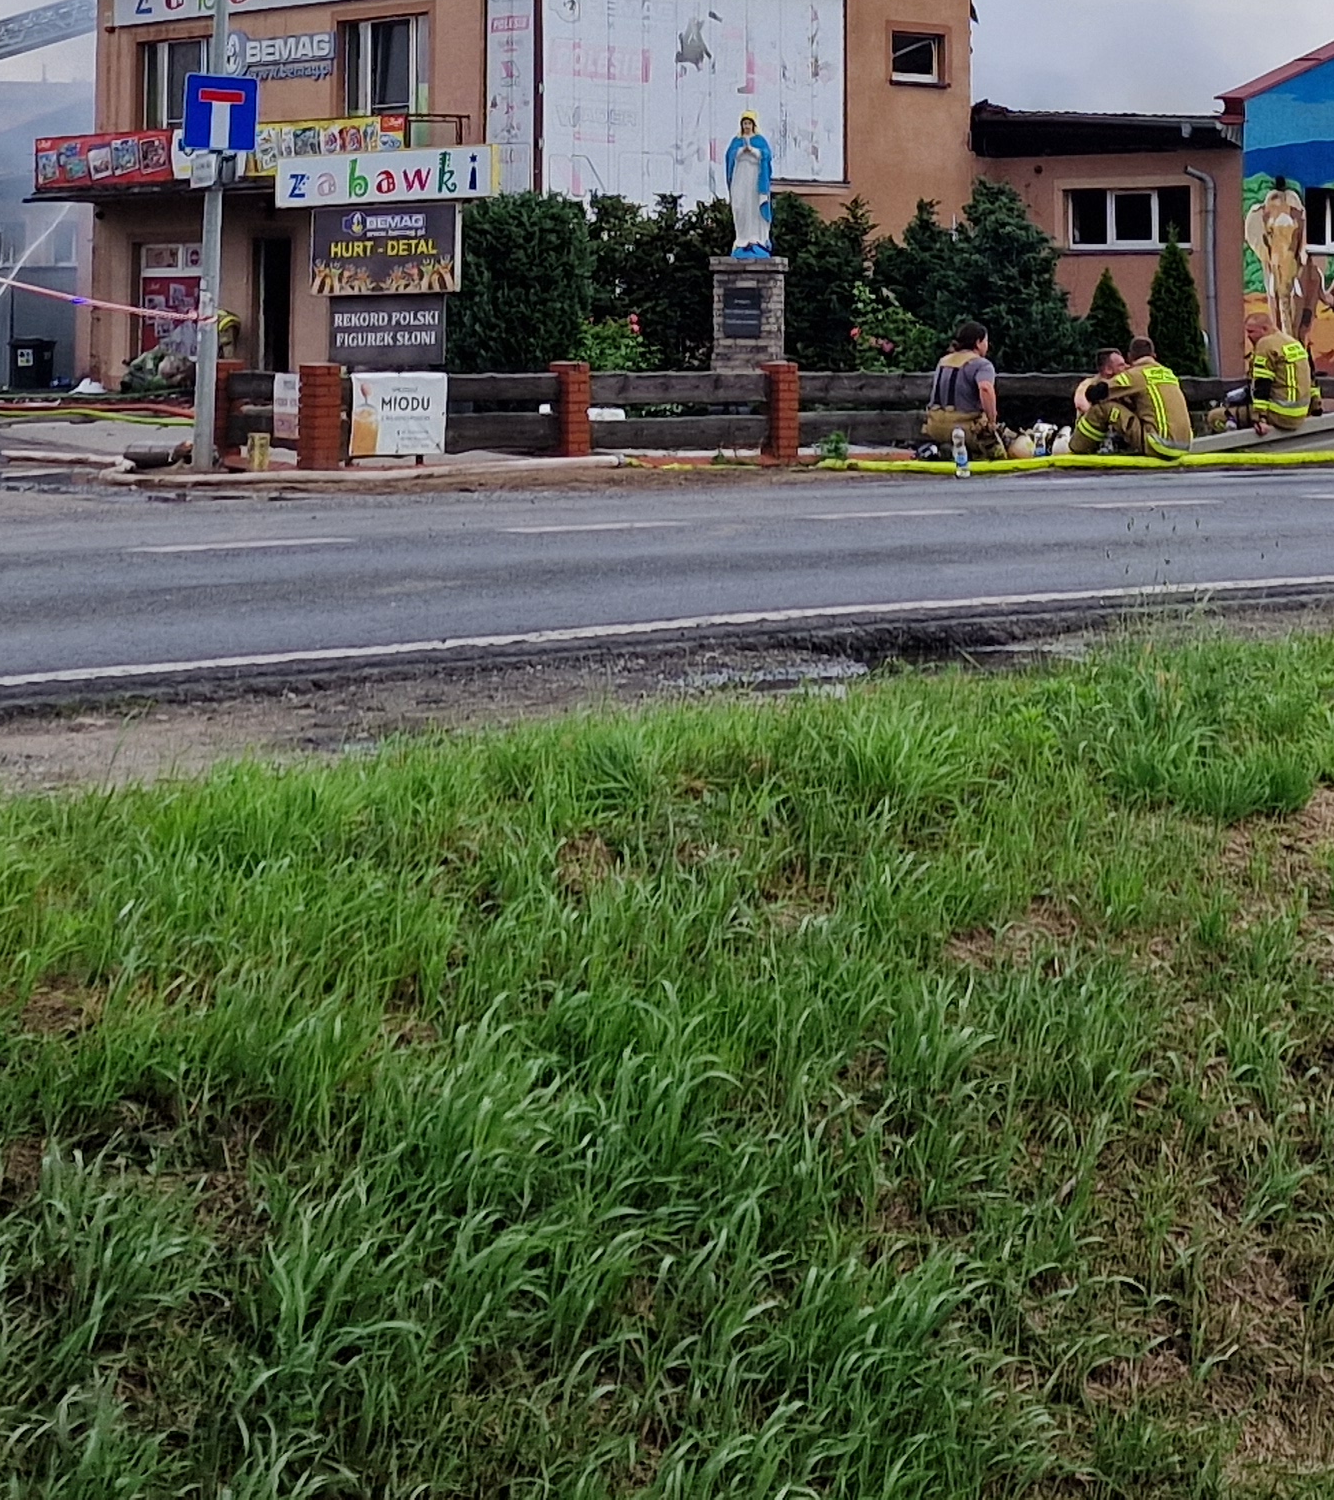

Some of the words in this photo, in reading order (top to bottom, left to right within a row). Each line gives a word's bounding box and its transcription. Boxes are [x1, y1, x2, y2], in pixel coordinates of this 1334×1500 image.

[247, 33, 330, 63] BEMAG
[288, 151, 478, 199] zabawki
[367, 214, 424, 229] BEMAG
[330, 241, 374, 258] HURT
[387, 239, 437, 256] DETAL
[334, 312, 388, 328] REKORD
[391, 311, 439, 326] POLSKI
[336, 332, 394, 347] FIGUREK
[396, 331, 436, 346] SŁONI
[381, 396, 430, 411] MIODU
